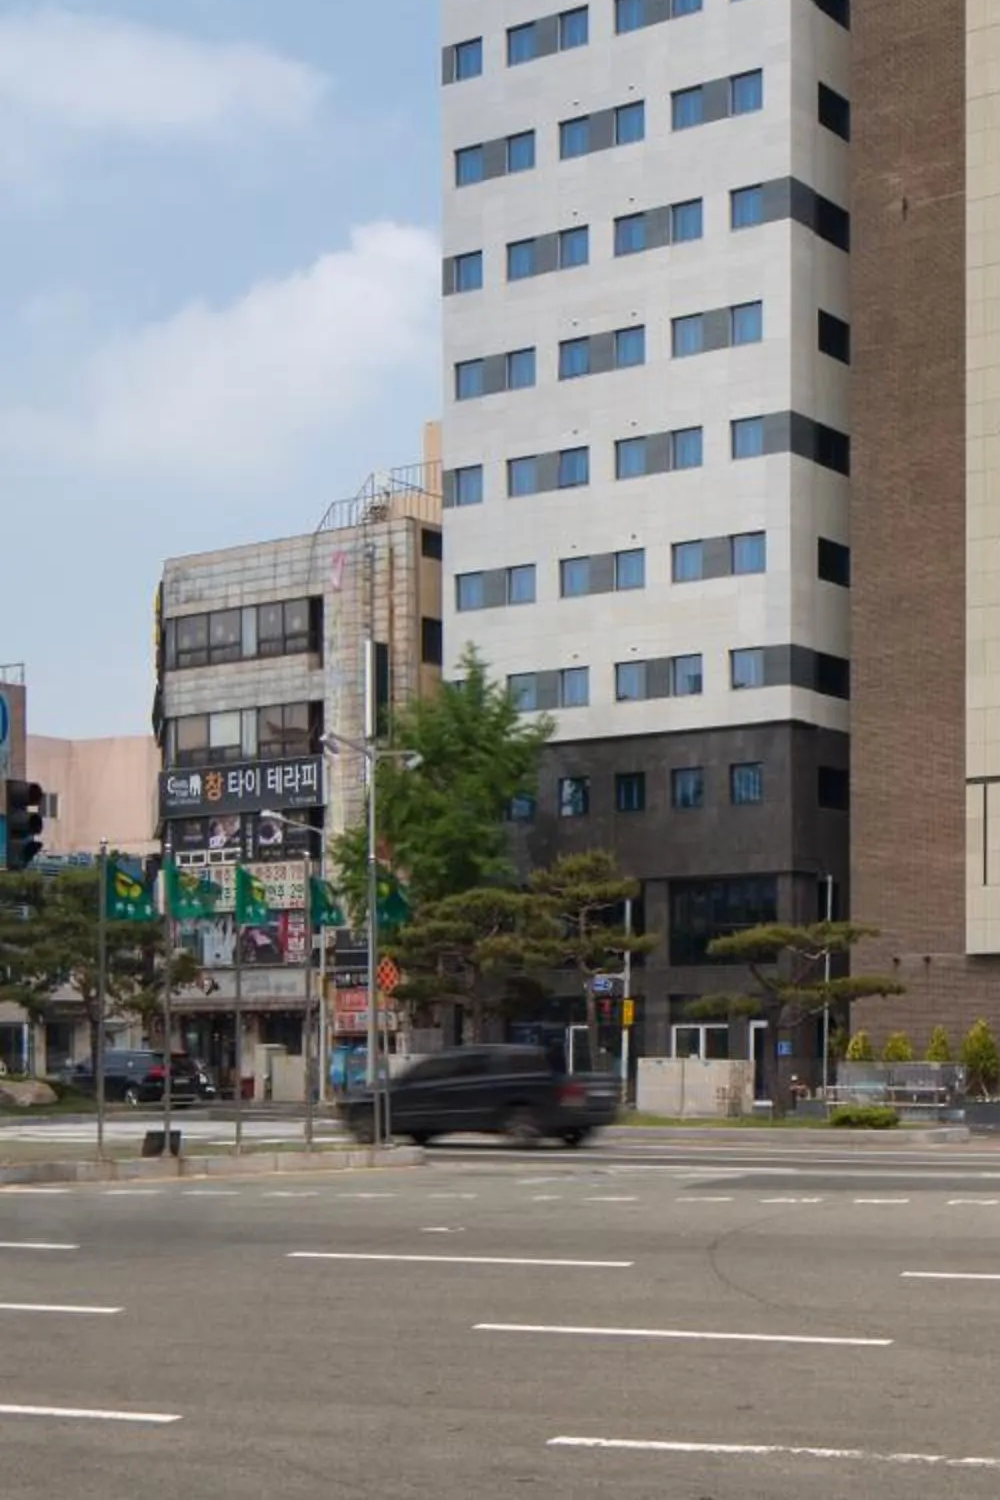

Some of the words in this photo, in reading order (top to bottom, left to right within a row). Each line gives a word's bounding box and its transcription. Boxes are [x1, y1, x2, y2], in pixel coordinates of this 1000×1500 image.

[205, 771, 224, 801] 창
[227, 768, 261, 798] 타이
[267, 762, 317, 796] 테라피
